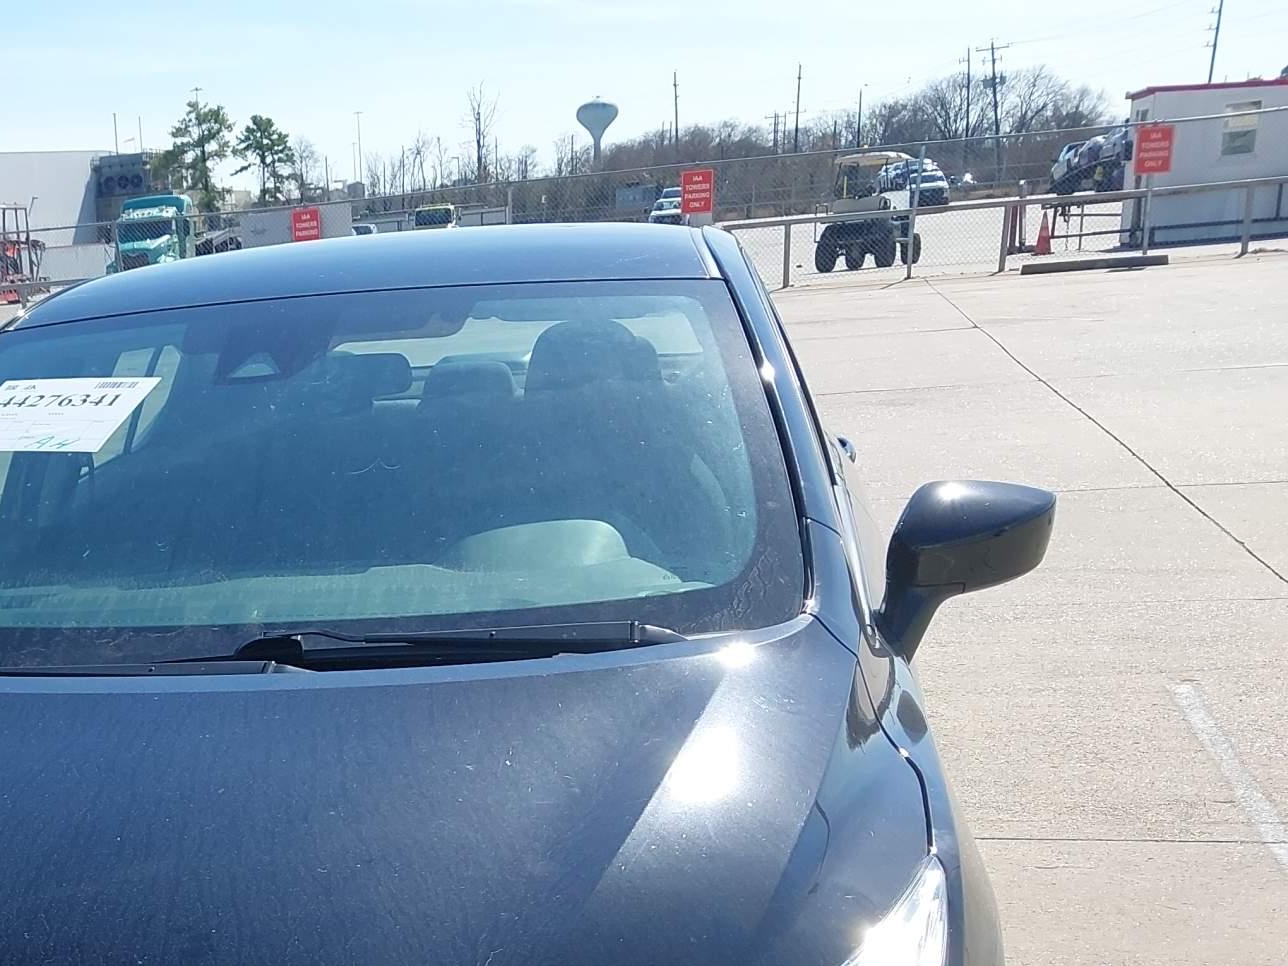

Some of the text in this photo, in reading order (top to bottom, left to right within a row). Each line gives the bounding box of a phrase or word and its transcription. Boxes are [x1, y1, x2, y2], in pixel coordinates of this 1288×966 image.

[1139, 150, 1169, 158] PARKING
[1144, 159, 1163, 168] ONLY
[684, 191, 710, 200] PARKING
